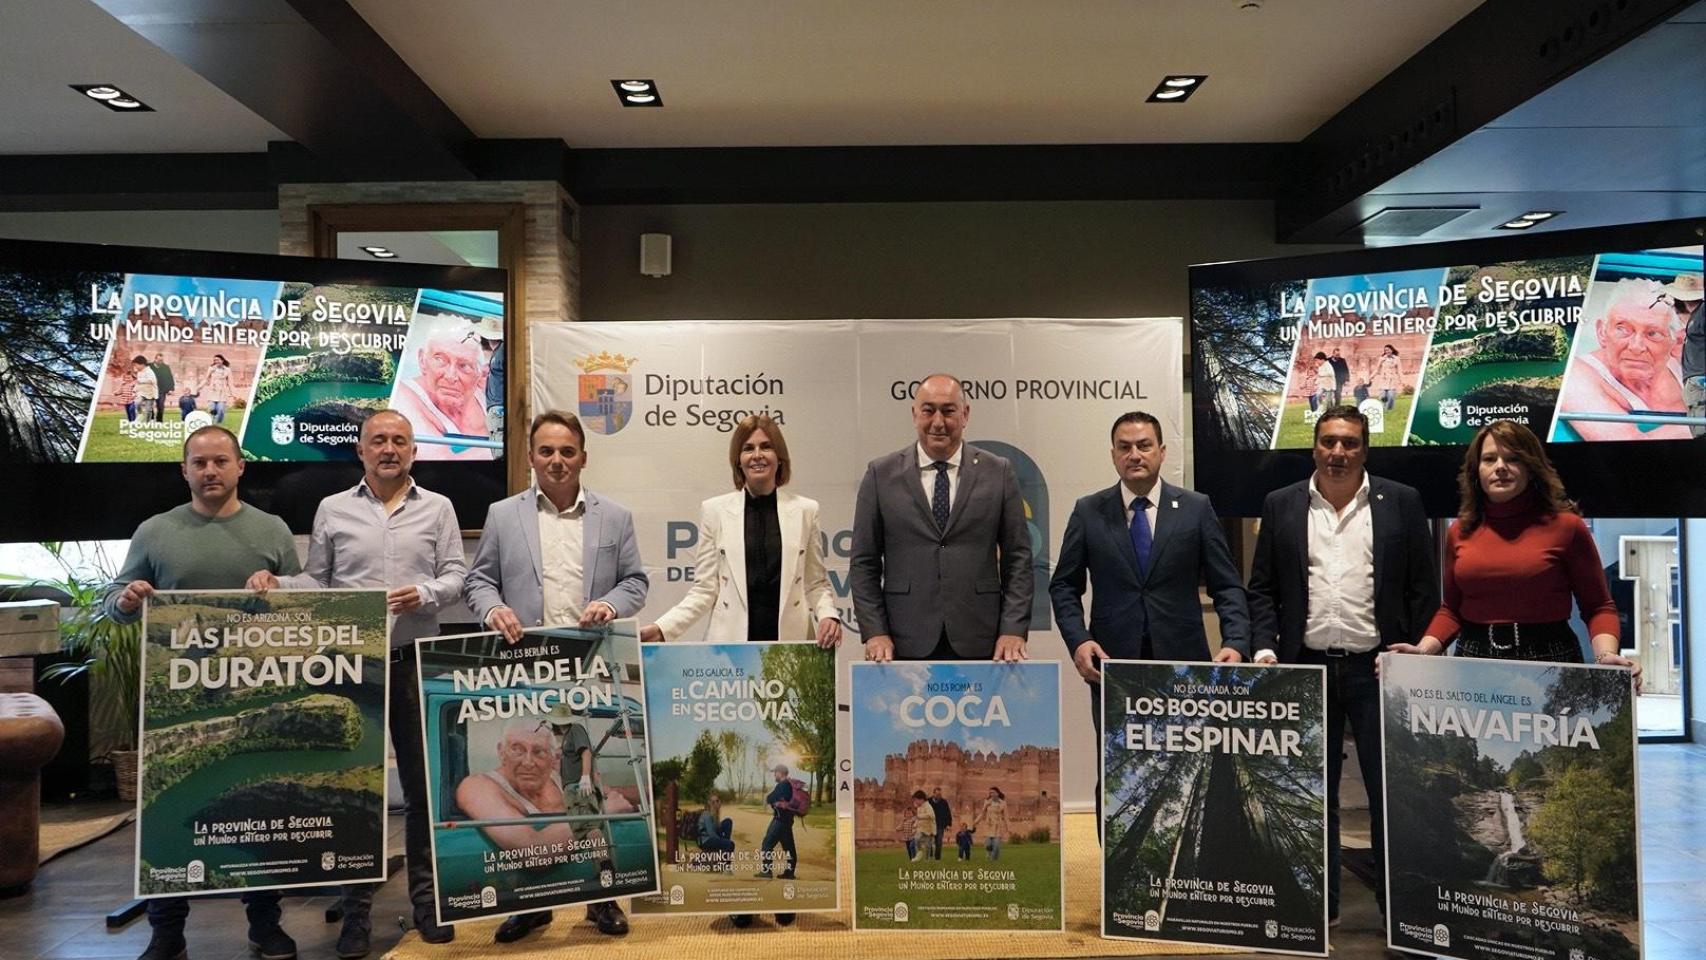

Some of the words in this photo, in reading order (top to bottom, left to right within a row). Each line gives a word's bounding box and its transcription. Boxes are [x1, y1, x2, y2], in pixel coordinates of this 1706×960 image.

[92, 284, 123, 313] LA
[134, 290, 262, 320] PROVINCIA
[273, 299, 301, 321] DE
[312, 295, 409, 325] SEGOVIA
[1281, 292, 1305, 317] LA
[1315, 283, 1428, 318] PROVINCIA
[1439, 284, 1467, 306] DE
[90, 319, 117, 341] UN
[126, 319, 194, 343] MUNDO
[201, 321, 271, 347] ENTERO
[279, 331, 311, 349] POR
[319, 331, 407, 355] DESCUBRIR
[1280, 321, 1301, 341] UN
[1308, 318, 1366, 340] MUNDO
[1373, 311, 1437, 336] ENTERO
[1445, 314, 1478, 331] POR
[645, 372, 784, 400] Diputación
[891, 379, 1007, 401] GORNO
[1016, 379, 1148, 400] PROVINCIAL
[645, 404, 677, 426] de
[1467, 403, 1528, 416] Diputación
[120, 418, 182, 430] Provincia
[300, 422, 358, 435] Diputación
[1467, 416, 1481, 426] de
[129, 429, 182, 441] Segovia
[300, 433, 314, 444] de
[317, 434, 358, 446] Segovia
[226, 614, 241, 623] NO
[242, 613, 252, 623] ES
[294, 612, 312, 622] SON
[170, 627, 219, 649] LAS
[223, 626, 313, 648] HOCES
[317, 625, 364, 646] DEL
[500, 650, 513, 660] NO
[514, 648, 523, 658] ES
[550, 644, 560, 655] ES
[170, 645, 363, 690] DURATÓN
[453, 662, 531, 693] NAVA
[534, 658, 571, 684] DE
[575, 656, 610, 680] LA
[683, 668, 694, 678] NO
[696, 668, 704, 677] ES
[736, 668, 745, 677] ES
[672, 688, 688, 700] EL
[688, 679, 785, 699] CAMINO
[927, 683, 939, 692] NO
[941, 683, 949, 692] ES
[974, 683, 983, 692] ES
[1174, 684, 1186, 694] NO
[1188, 685, 1197, 694] ES
[1232, 686, 1250, 696] SON
[1410, 688, 1422, 698] NO
[1424, 689, 1434, 699] ES
[1436, 690, 1444, 700] EL
[1446, 690, 1472, 702] SALTO
[1474, 693, 1487, 703] DEL
[1521, 696, 1532, 706] ES
[457, 680, 612, 724] ASUNCIÓN
[672, 704, 691, 716] EN
[693, 702, 796, 722] SEGOVIA
[900, 695, 1011, 728] COCA
[1126, 697, 1164, 716] LOS
[1168, 698, 1267, 722] BOSQUES
[1271, 702, 1300, 720] DE
[1410, 705, 1600, 750] NAVAFRÍA
[1126, 723, 1162, 750] EL
[1166, 725, 1303, 757] ESPINAR
[195, 820, 208, 834] LA
[212, 818, 266, 833] PROVINCIA
[271, 819, 284, 830] DE
[288, 816, 333, 829] SEGOVIA
[484, 851, 496, 863] LA
[500, 845, 548, 861] PROVINCIA
[552, 843, 563, 853] DE
[567, 838, 608, 851] SEGOVIA
[899, 868, 909, 880] LA
[913, 868, 959, 881] PROVINCIA
[962, 870, 973, 880] DE
[977, 868, 1015, 881] SEGOVIA
[1438, 886, 1450, 901] LA
[1455, 892, 1509, 910] PROVINCIA
[1513, 902, 1526, 913] DE
[1531, 902, 1578, 921] SEGOVIA
